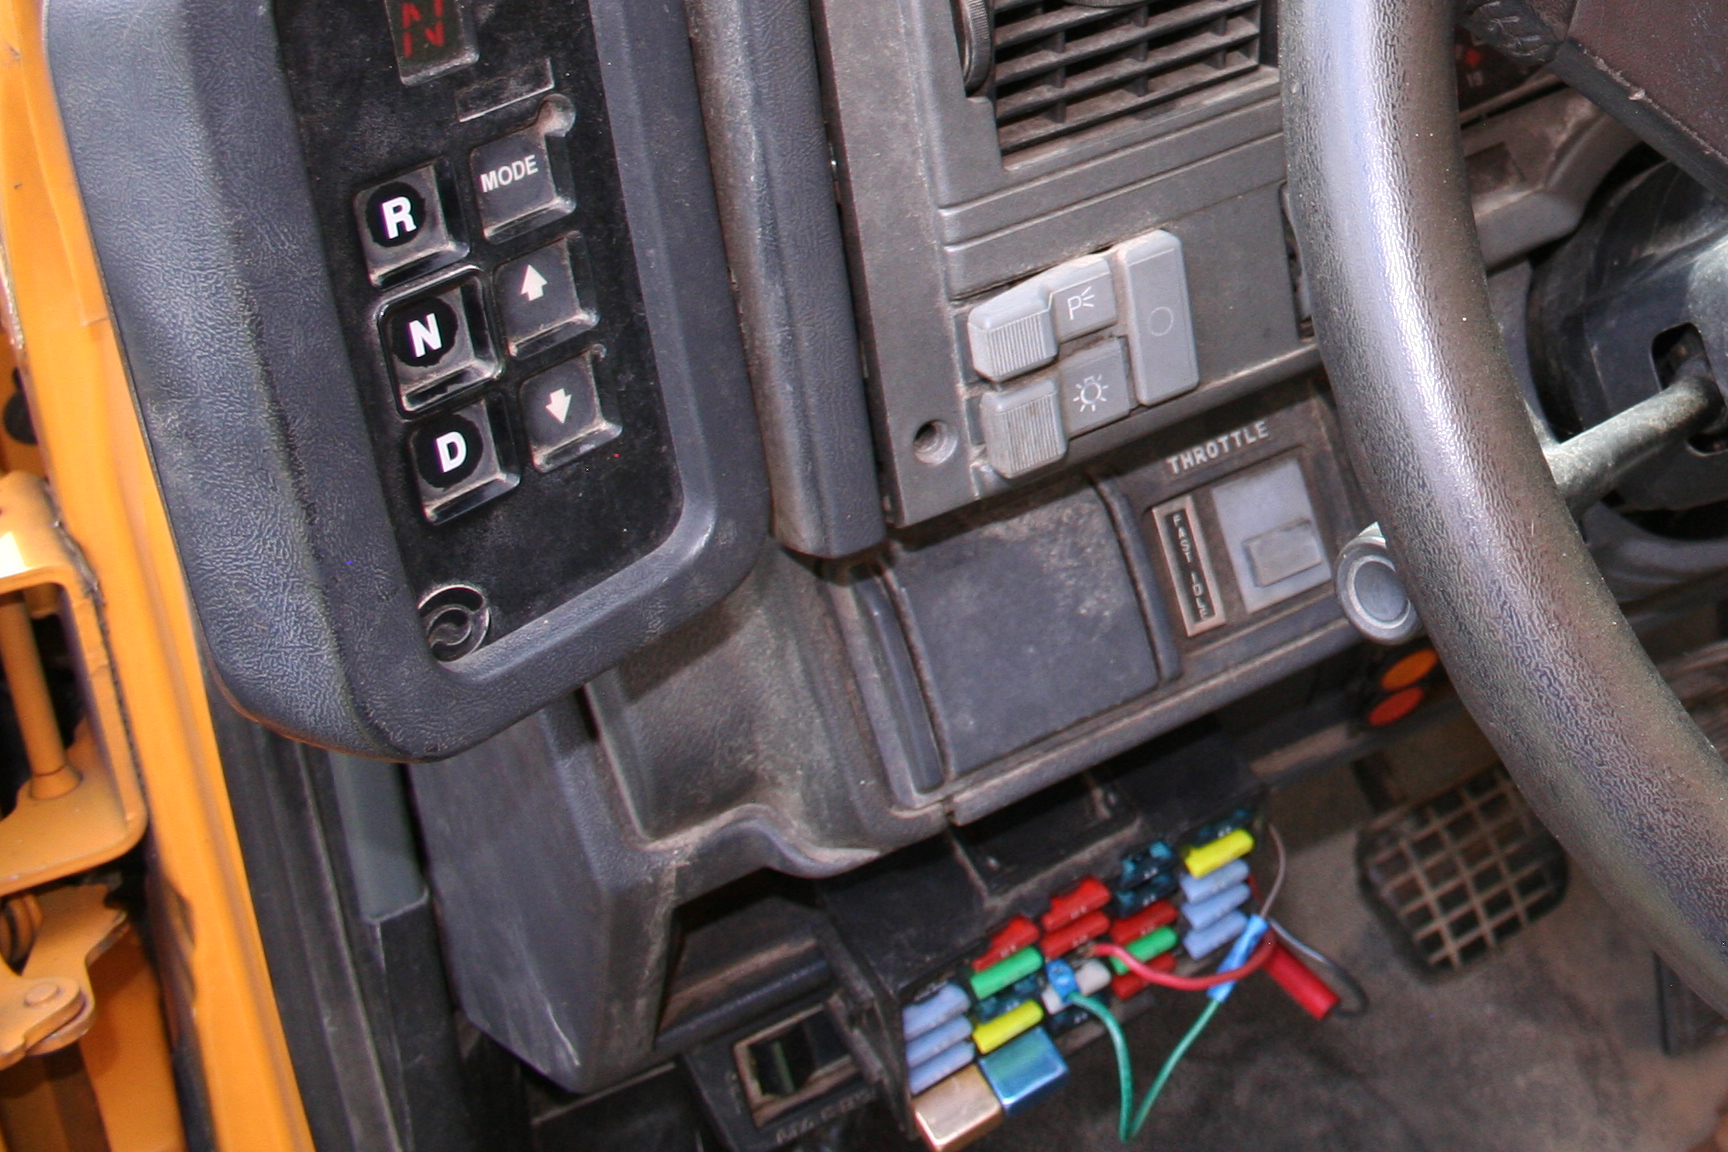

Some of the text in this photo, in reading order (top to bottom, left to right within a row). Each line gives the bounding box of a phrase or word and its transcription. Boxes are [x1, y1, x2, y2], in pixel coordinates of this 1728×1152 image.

[480, 154, 539, 193] MODE
[380, 195, 418, 240] R
[408, 313, 443, 358] N
[434, 430, 467, 474] D
[1165, 419, 1269, 474] THROTTLE
[1172, 513, 1209, 619] FAST IDLE
